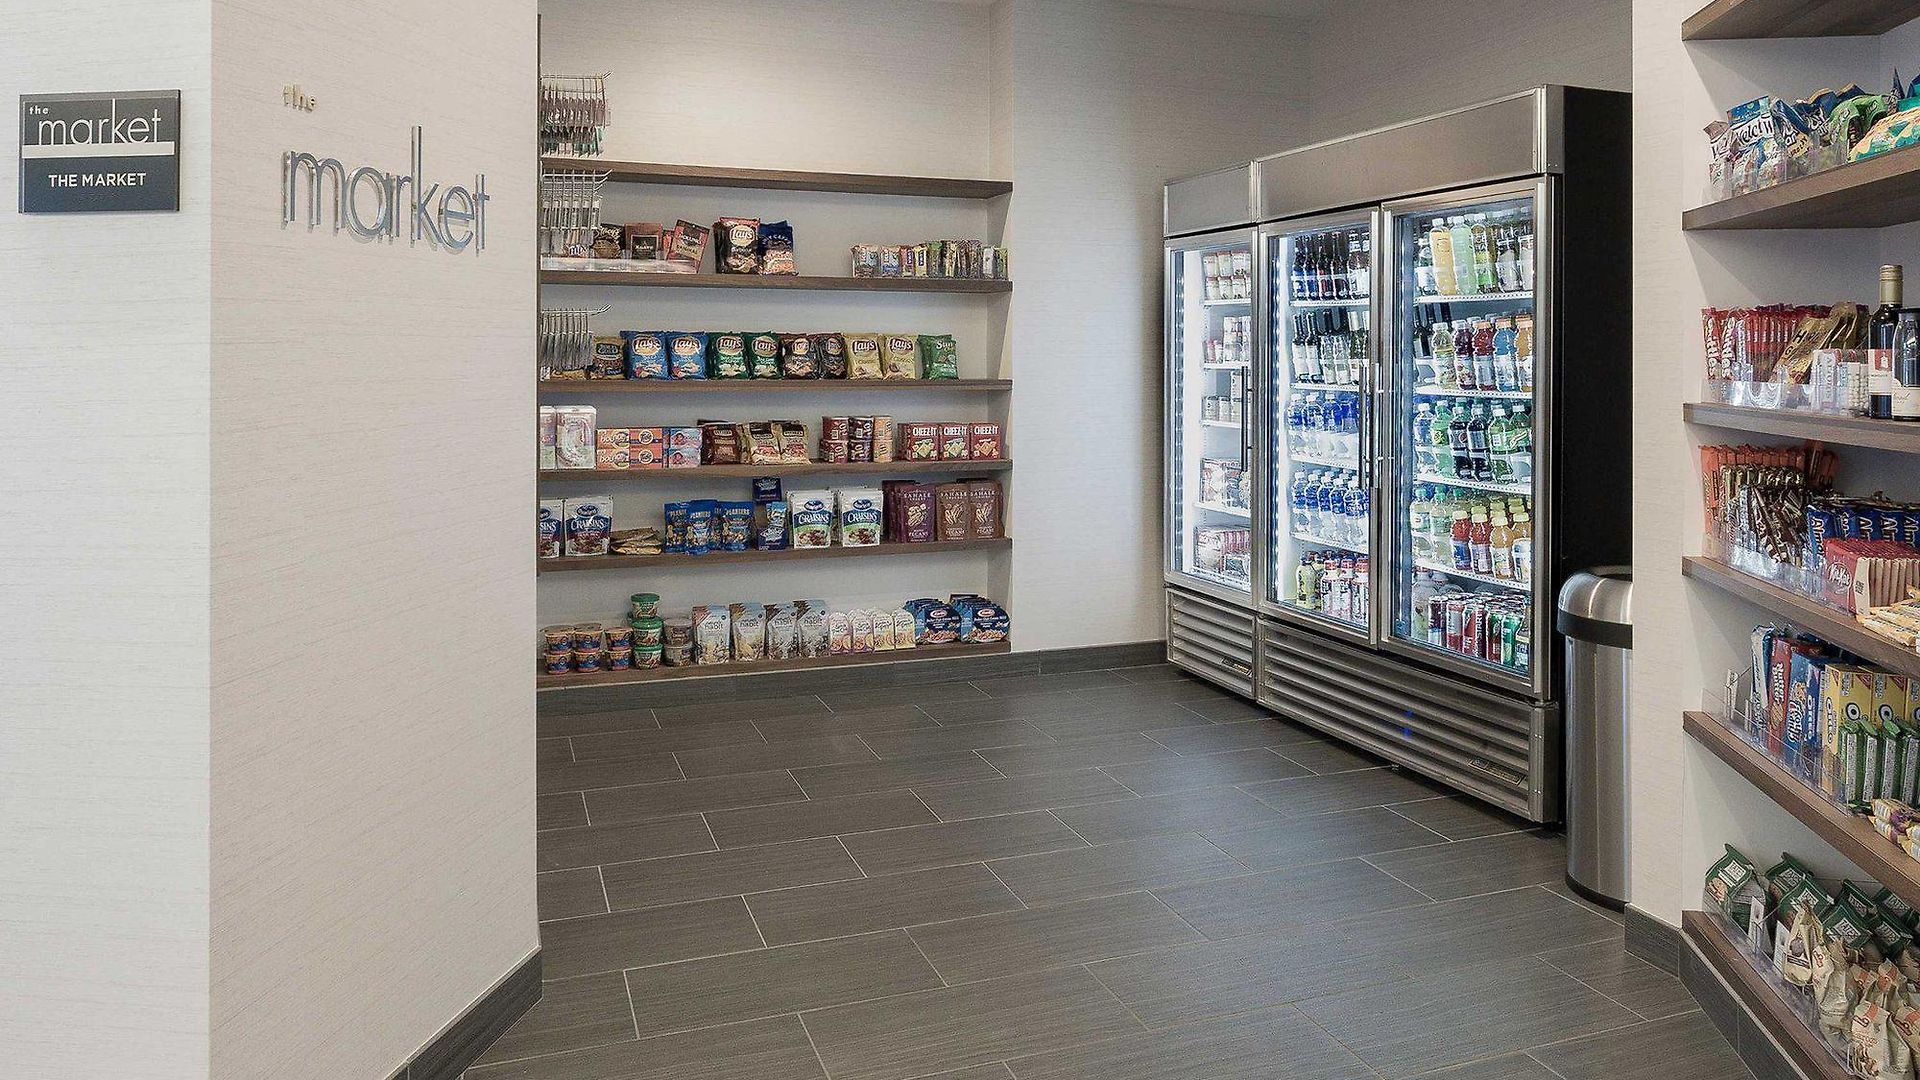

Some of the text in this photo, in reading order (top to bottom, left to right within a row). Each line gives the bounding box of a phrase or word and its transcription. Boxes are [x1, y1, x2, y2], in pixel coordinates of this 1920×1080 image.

[29, 105, 49, 116] the
[283, 84, 317, 113] the
[38, 98, 162, 145] market
[48, 172, 147, 188] THE MARKET
[282, 125, 490, 255] market
